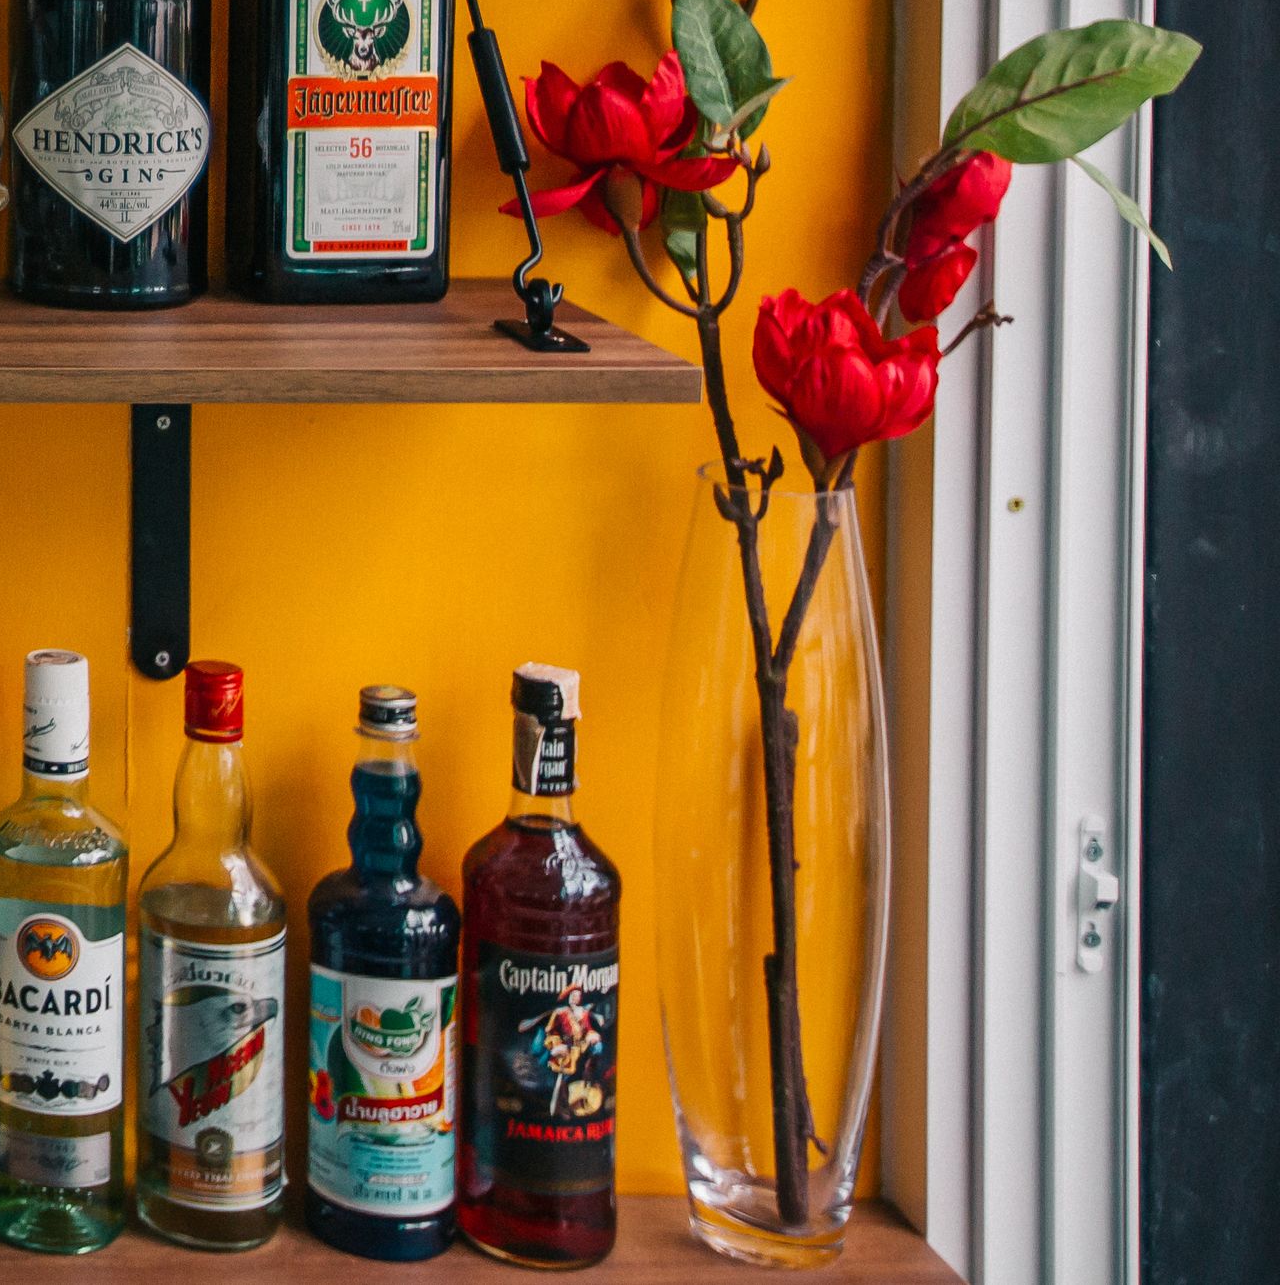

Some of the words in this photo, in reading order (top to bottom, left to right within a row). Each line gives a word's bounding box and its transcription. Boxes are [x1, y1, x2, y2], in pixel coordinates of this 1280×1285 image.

[295, 86, 433, 119] Jägermeister
[33, 127, 202, 155] HENDRICK'S
[350, 137, 372, 158] 56
[39, 155, 86, 164] DISTILLED
[99, 168, 153, 183] GIN
[99, 199, 118, 209] 44%
[499, 958, 568, 995] Captain
[45, 1025, 102, 1037] BLANCA
[506, 1118, 584, 1143] JAMAICA
